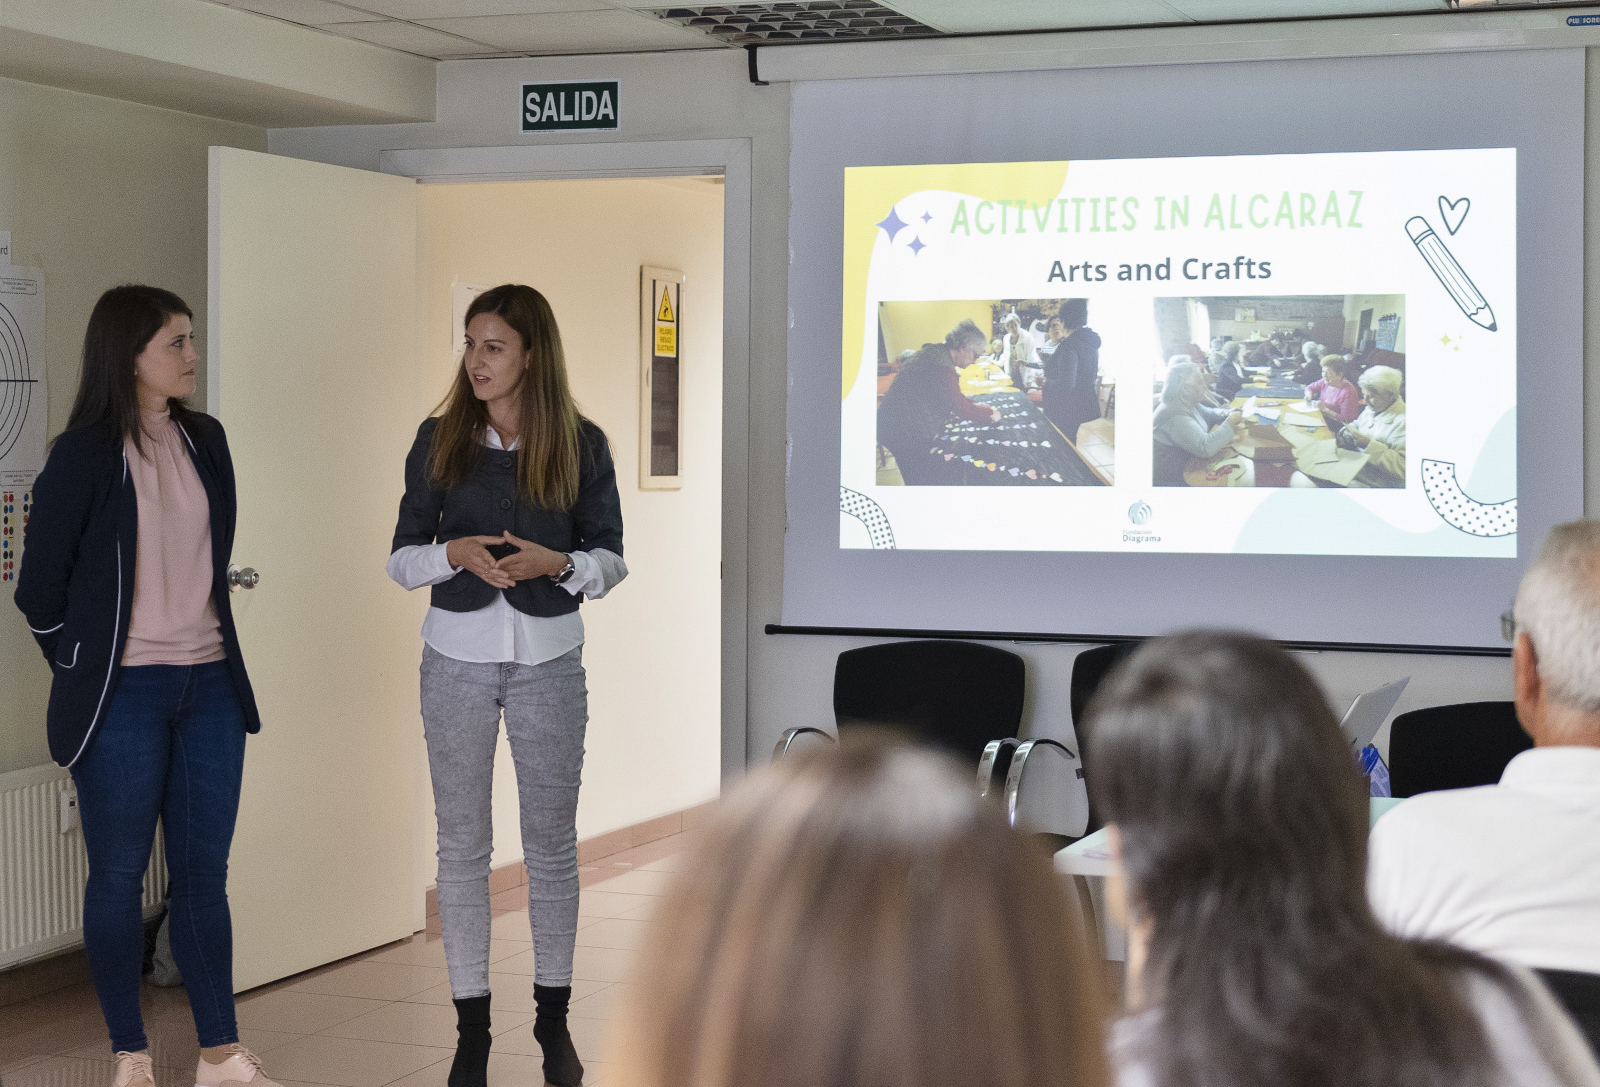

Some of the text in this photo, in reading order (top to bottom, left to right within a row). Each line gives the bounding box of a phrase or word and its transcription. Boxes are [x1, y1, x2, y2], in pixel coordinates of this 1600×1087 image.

[525, 90, 615, 123] SALIDA
[950, 189, 1364, 236] ACTIVITIES IN ALCARAZ
[1047, 255, 1272, 283] Arts and Crafts
[1122, 535, 1161, 543] Diagrama
